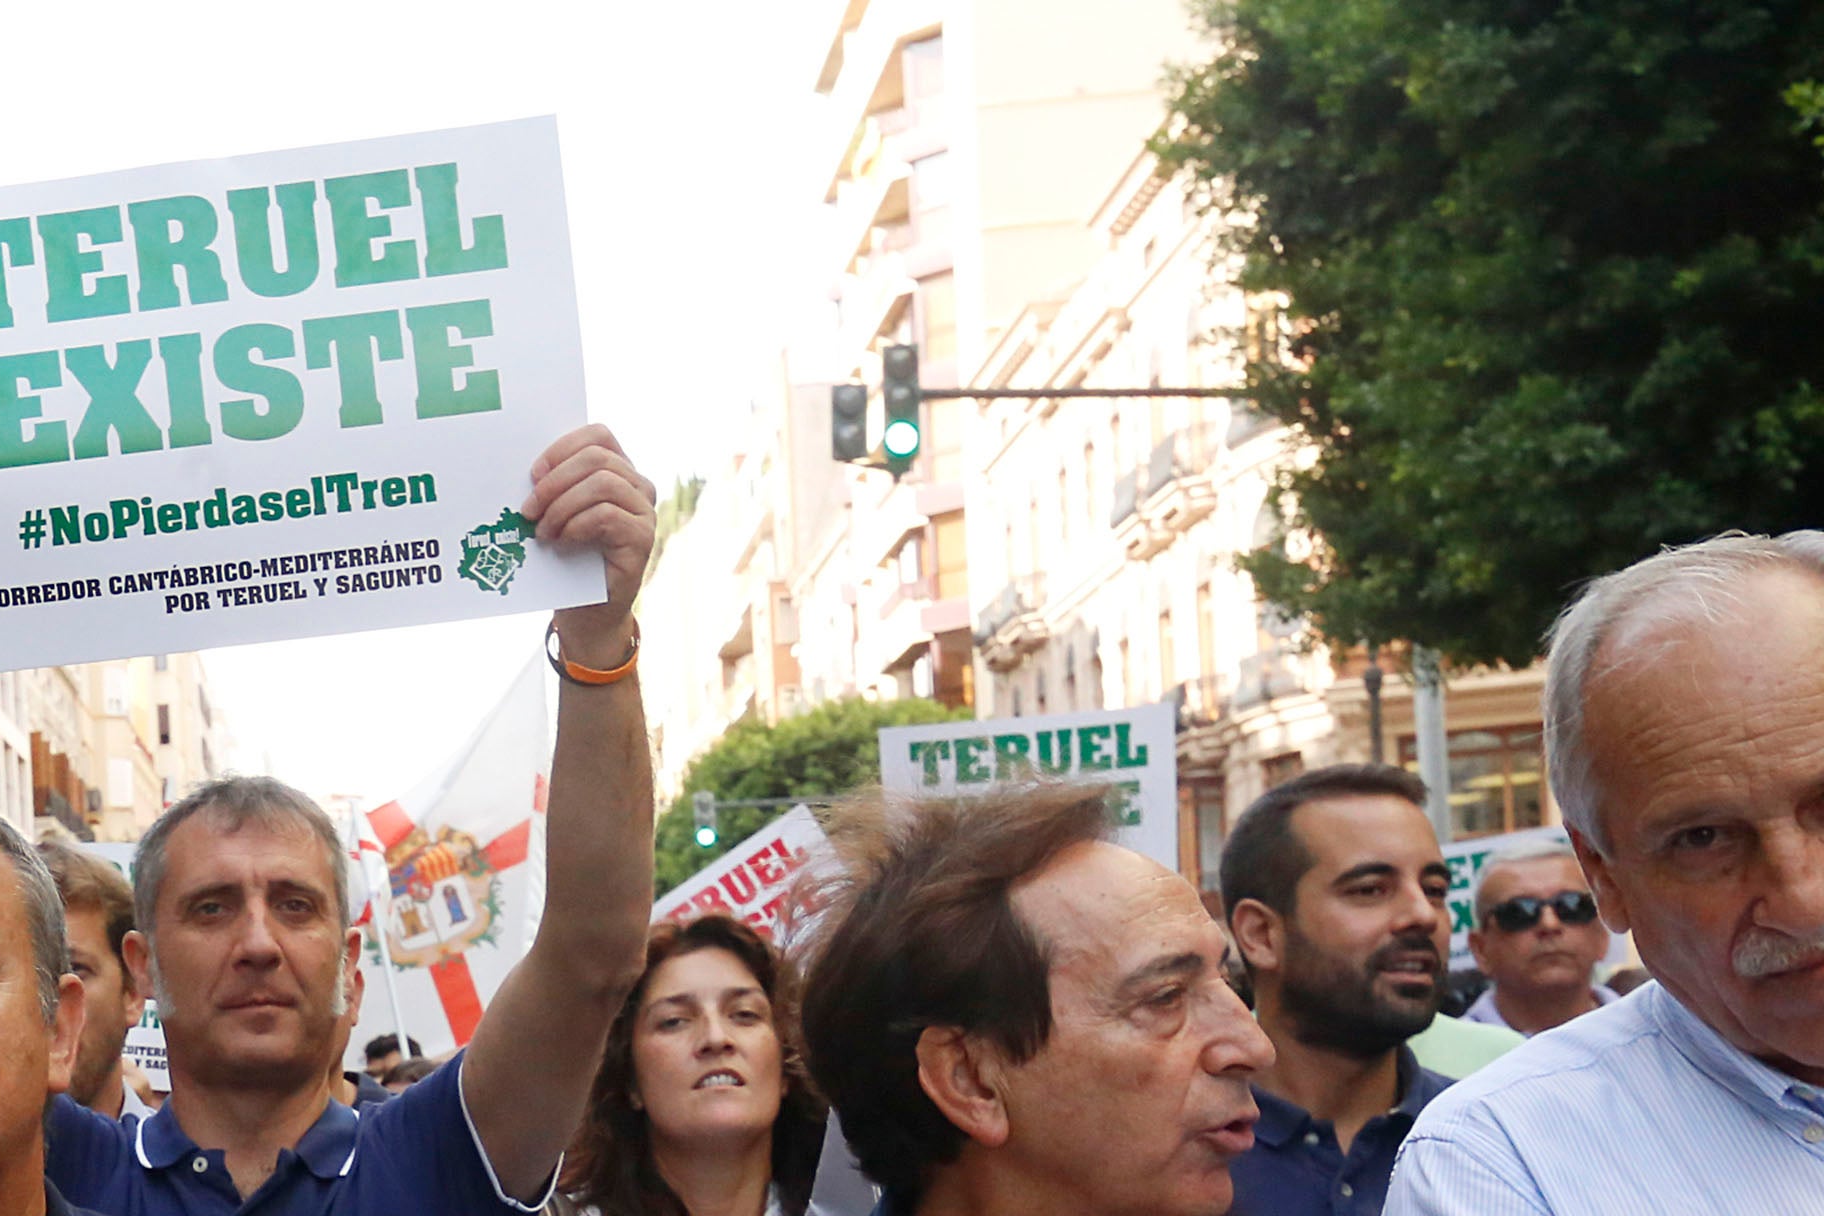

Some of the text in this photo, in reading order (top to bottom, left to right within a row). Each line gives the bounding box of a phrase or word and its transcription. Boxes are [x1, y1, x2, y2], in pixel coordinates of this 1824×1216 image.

[19, 472, 437, 549] #NoPierdaselTren
[109, 539, 440, 595] CANTÁBRICO-MEDITERRÁNEO
[165, 564, 442, 614] POR TERUEL Y SAGUNTO
[909, 723, 1148, 786] TERUEL
